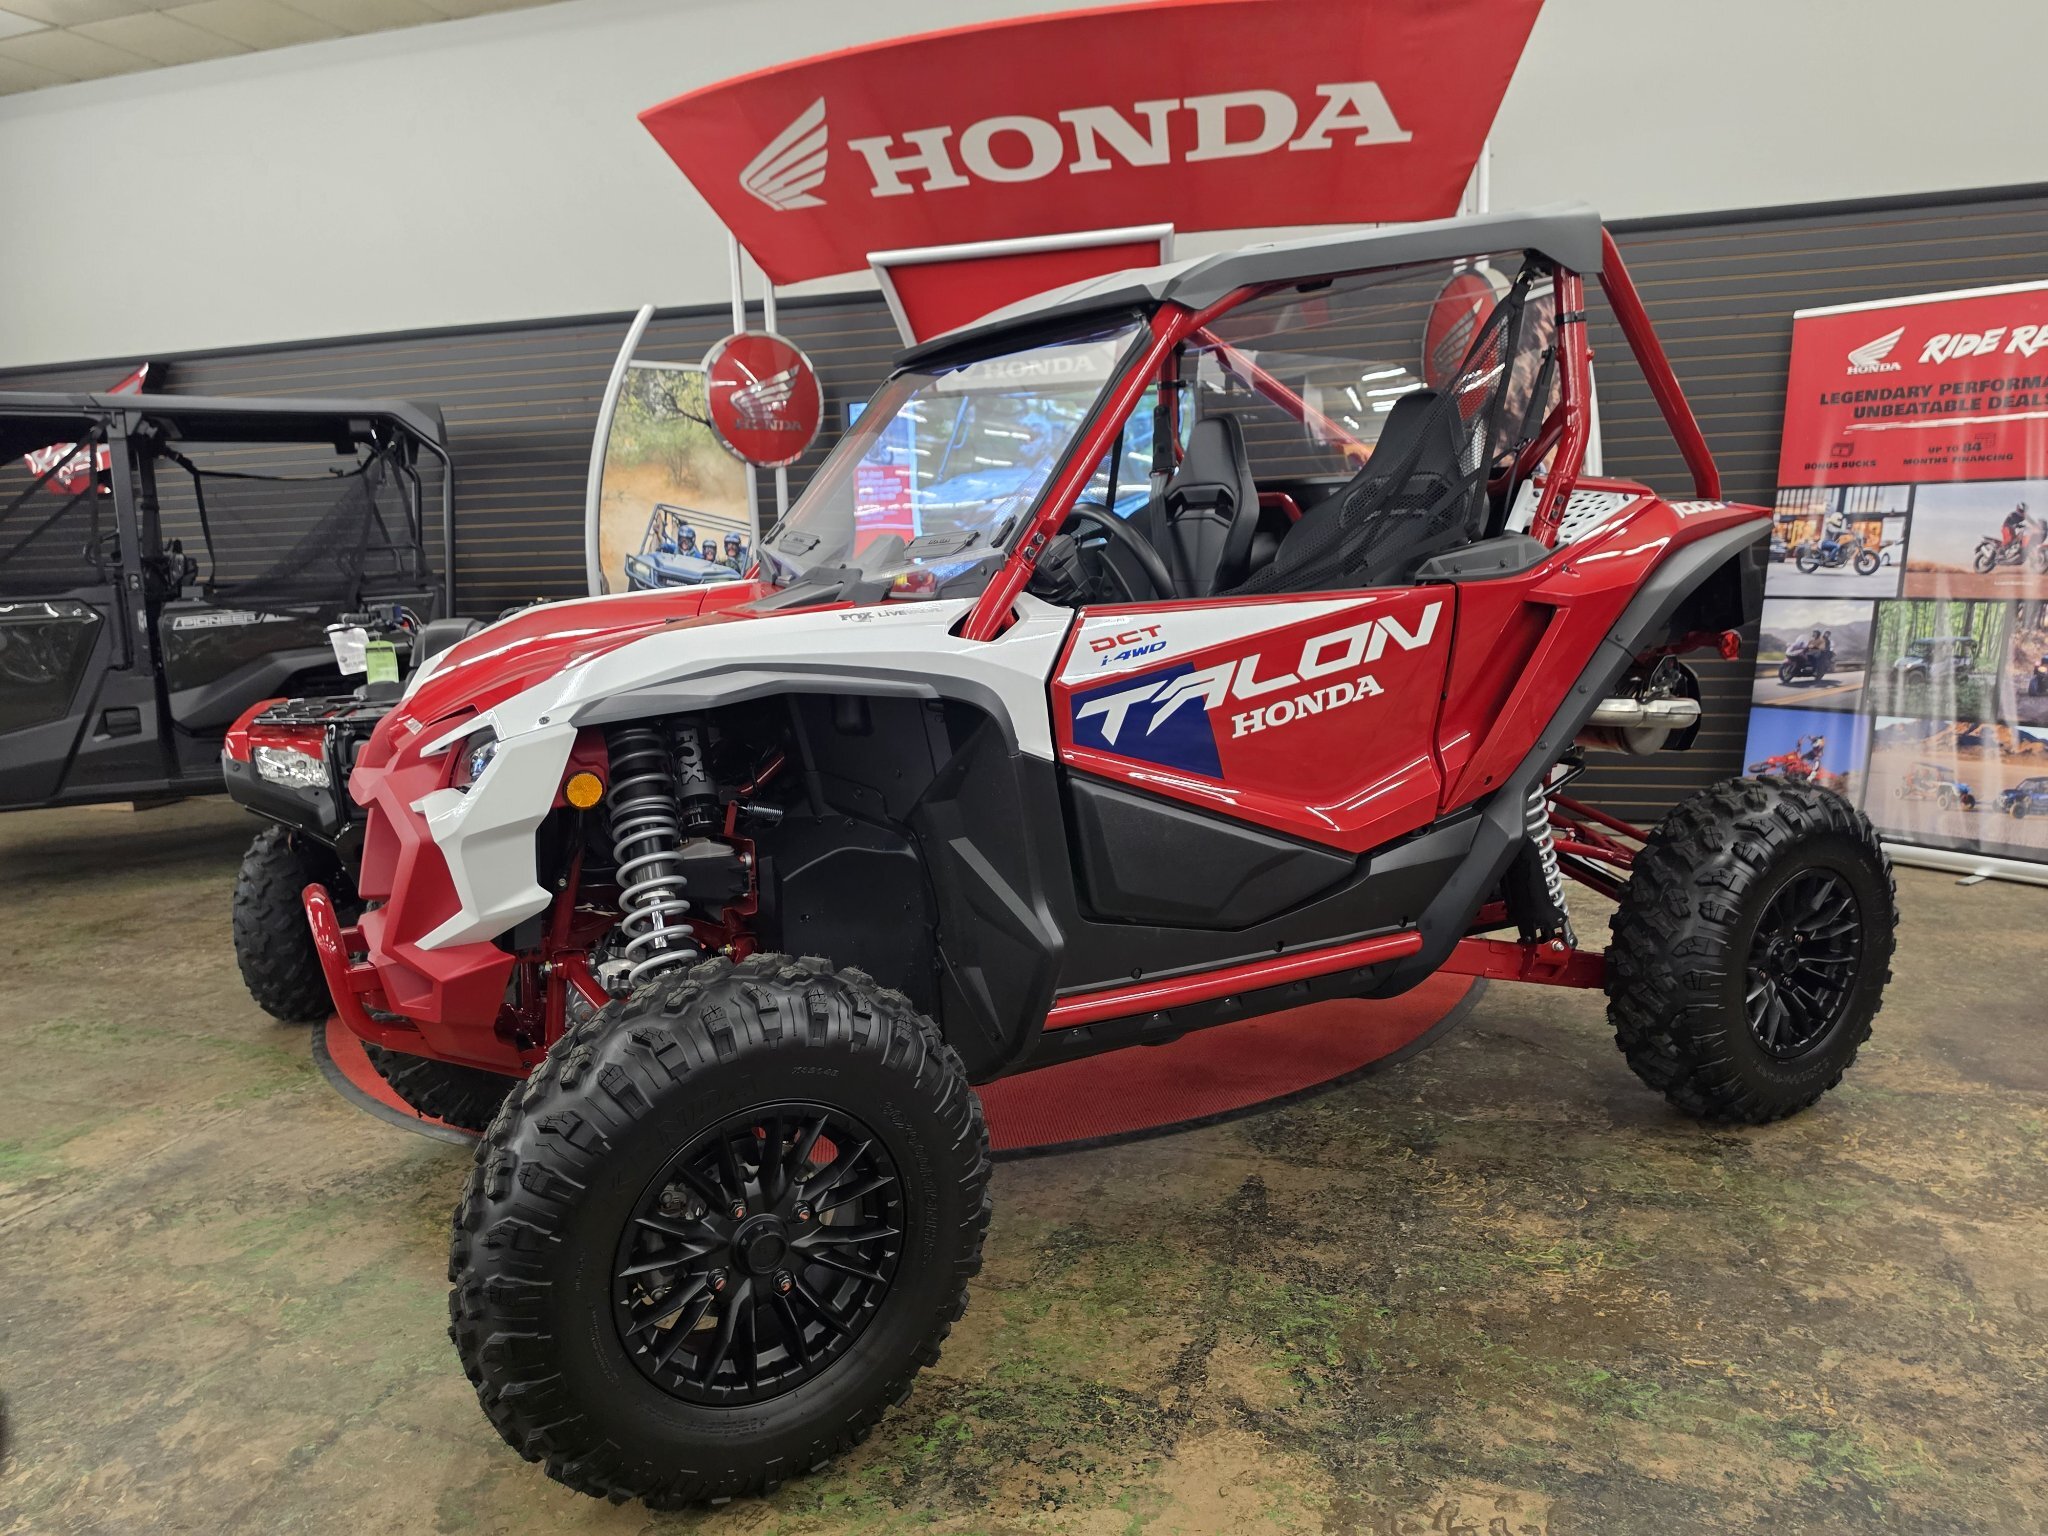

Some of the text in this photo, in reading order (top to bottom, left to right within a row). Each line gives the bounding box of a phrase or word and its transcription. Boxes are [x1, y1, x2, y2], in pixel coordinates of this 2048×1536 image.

[848, 80, 1412, 199] HONDA
[1918, 326, 2008, 365] RIDE
[984, 355, 1097, 380] HONDA
[1846, 362, 1902, 376] HONDA
[1819, 385, 1933, 406] LEGENDARY
[1853, 397, 1981, 420] UNBEATABLE
[735, 418, 803, 432] HONDA
[1903, 453, 2014, 466] MONTHS FINANCING
[1928, 441, 1983, 454] UP TO 84
[1804, 459, 1877, 471] BONUS BUCKS
[839, 611, 874, 623] FOX
[1089, 624, 1162, 653] DCT
[1100, 640, 1167, 667] i-4WD
[1076, 600, 1443, 746] TALON
[1232, 674, 1384, 740] HONDA
[675, 733, 707, 786] FOX
